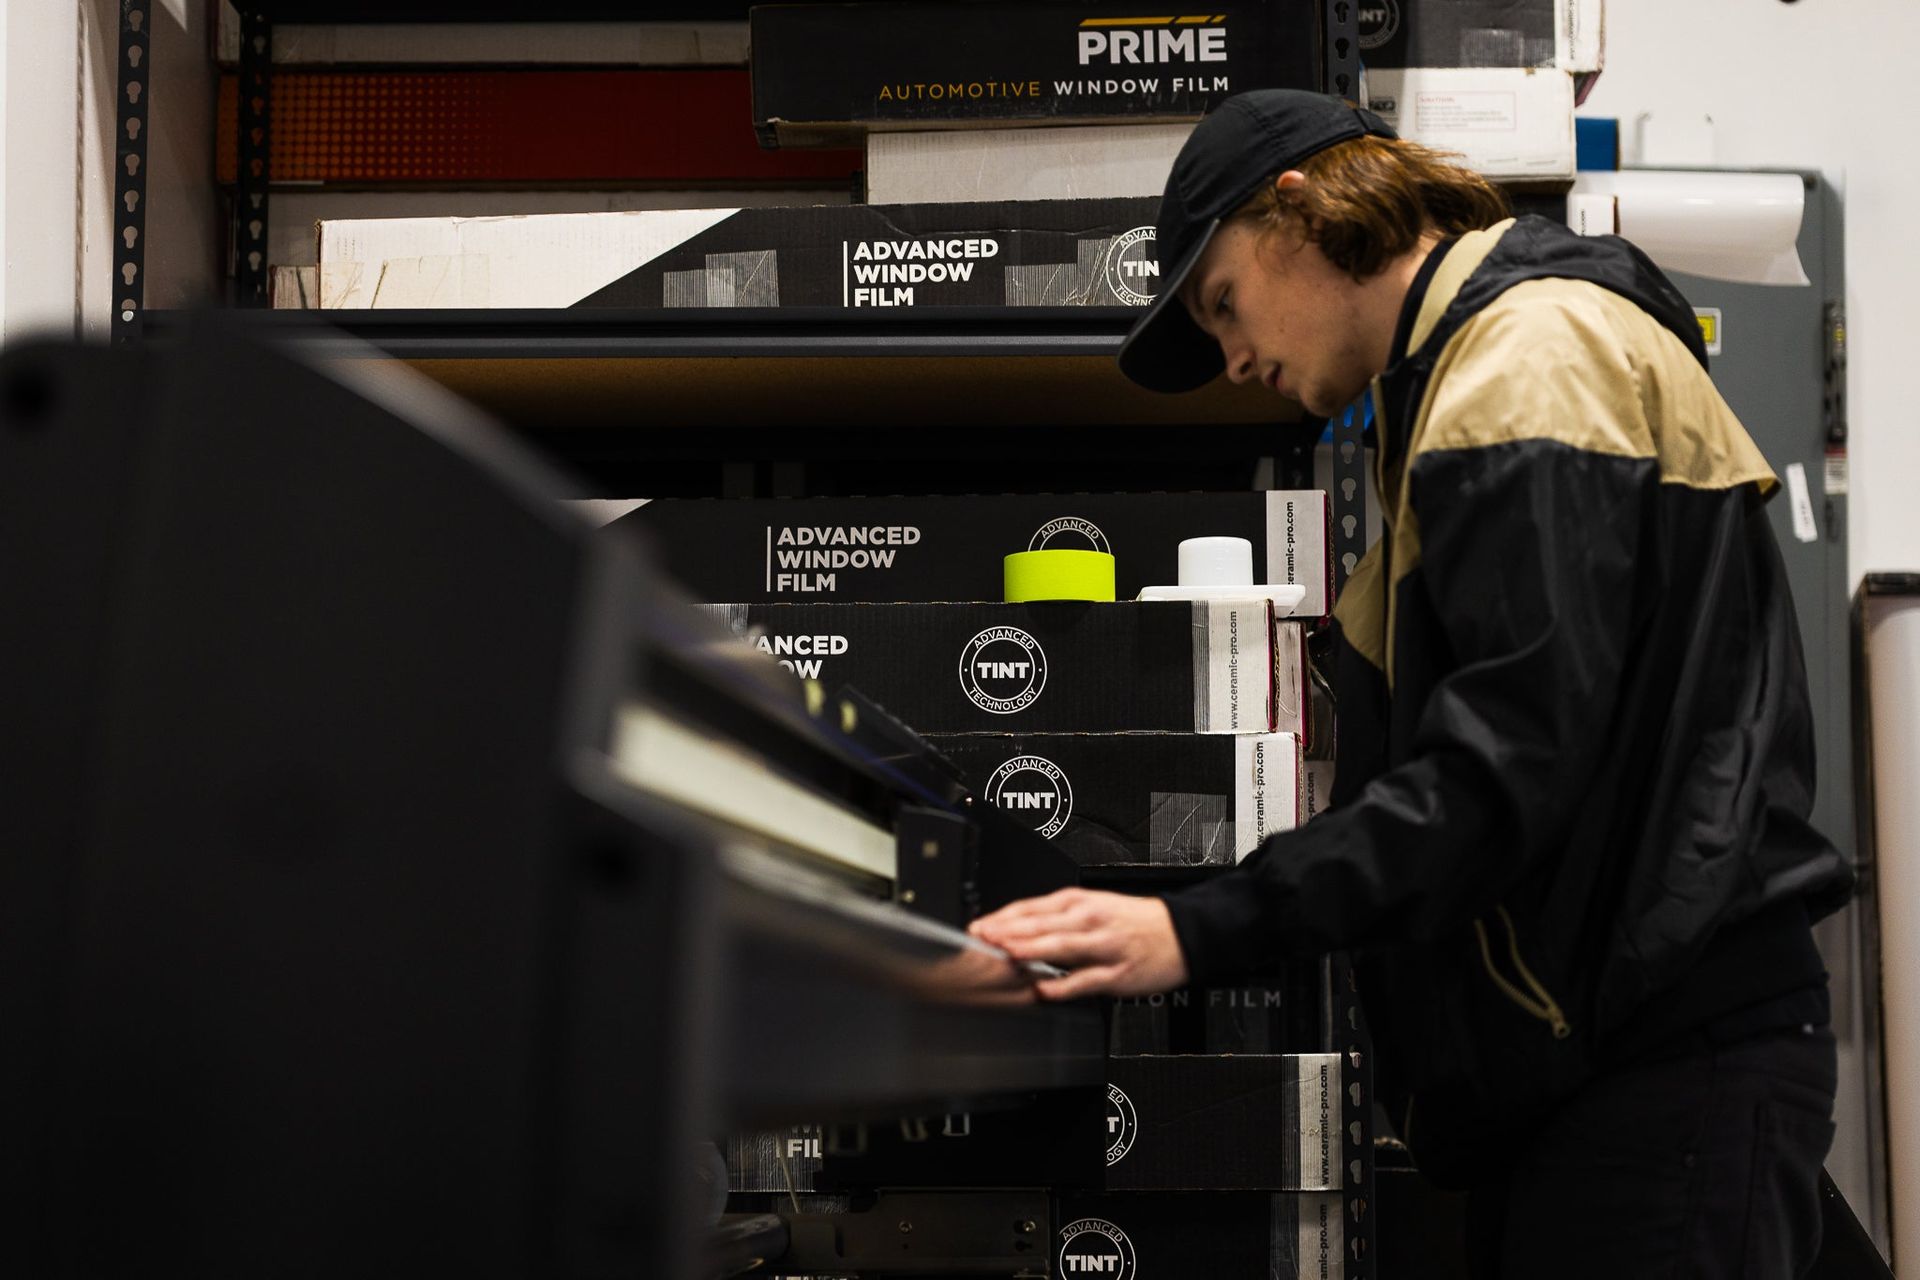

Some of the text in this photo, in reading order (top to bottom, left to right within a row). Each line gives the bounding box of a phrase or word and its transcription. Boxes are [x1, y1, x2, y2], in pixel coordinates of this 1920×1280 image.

[1078, 28, 1228, 64] PRIME
[879, 77, 1229, 100] AUTOMOTIVE WINDOW FILM
[853, 239, 999, 260] ADVANCED
[854, 263, 974, 283] WINDOW
[854, 287, 914, 306] FILM
[777, 526, 921, 545] ADVANCED
[1041, 519, 1099, 540] ADVANCED
[1286, 501, 1295, 585] eramic-pro.com
[777, 550, 896, 568] WINDOW
[777, 573, 836, 592] FILM
[752, 635, 849, 655] ANCED
[974, 629, 1035, 650] ADVANCED
[977, 662, 1030, 679] TINT
[1229, 611, 1239, 729] www.ceramic-pro.com
[969, 686, 1036, 711] TECHNOLOGY
[999, 759, 1060, 780] ADVANCED
[1002, 792, 1056, 809] TINT
[1208, 990, 1281, 1008] FILM
[1320, 1065, 1329, 1185] www.ceramic-pro.com
[1062, 1221, 1123, 1242] ADVANCED
[1065, 1254, 1119, 1272] TINT
